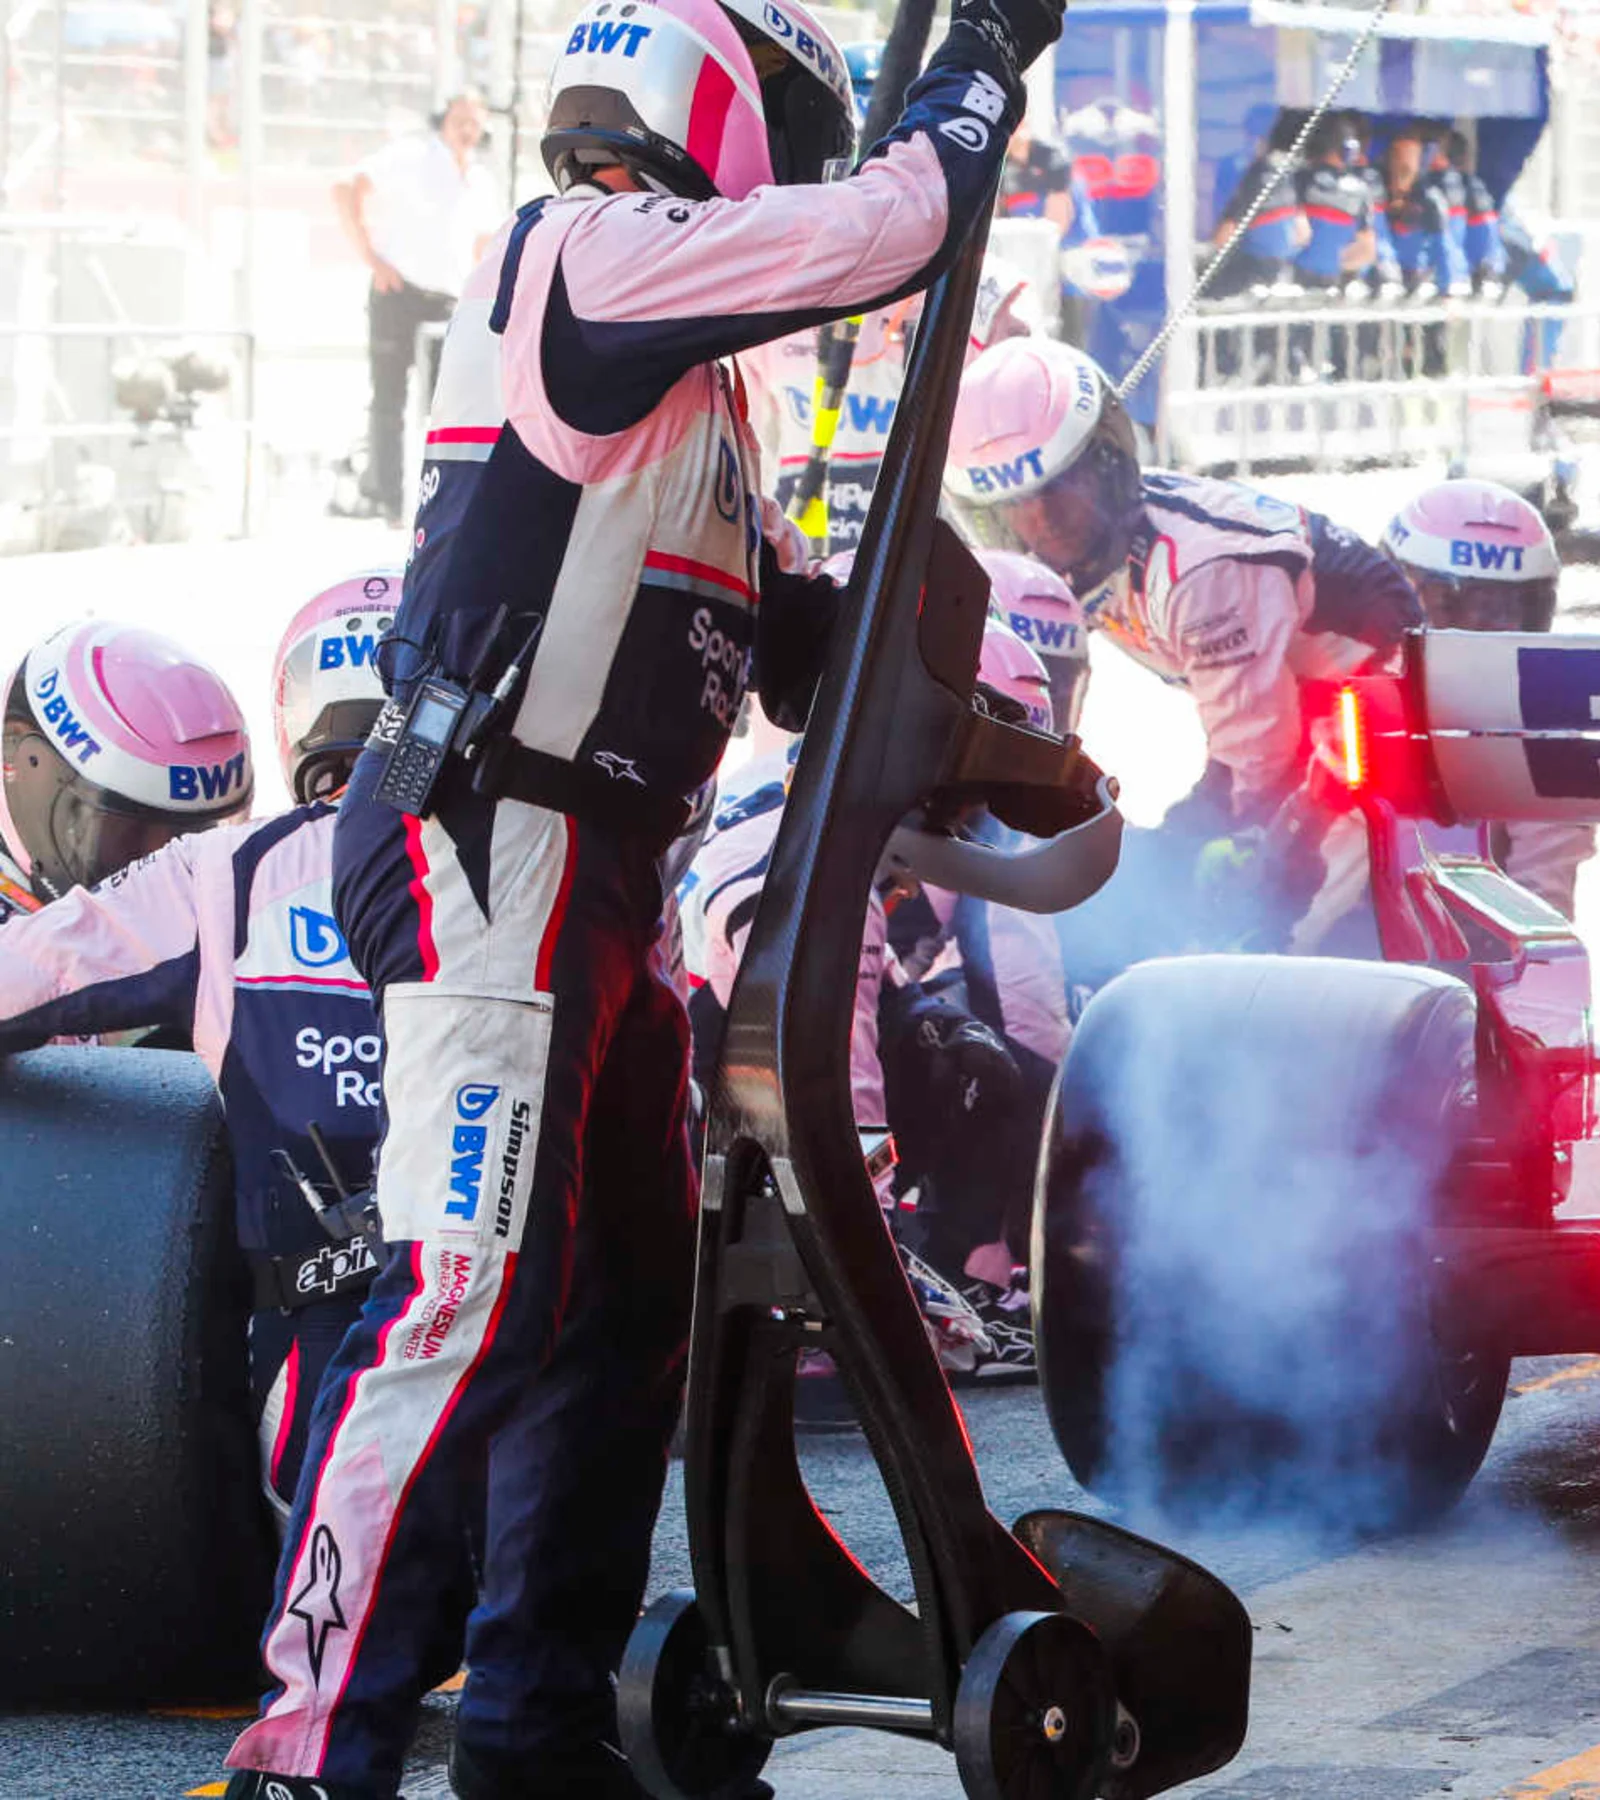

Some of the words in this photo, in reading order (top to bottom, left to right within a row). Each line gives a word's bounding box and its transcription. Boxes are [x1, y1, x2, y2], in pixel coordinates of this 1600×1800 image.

[565, 22, 652, 58] BWT
[969, 448, 1045, 494] BWT
[1451, 539, 1525, 571] BWT
[1009, 611, 1080, 649] BWT
[43, 694, 103, 765] BWT
[169, 752, 246, 801] BWT
[445, 1124, 491, 1221] BWT
[495, 1100, 531, 1239] Simpson
[418, 1253, 473, 1360] MAGNESIUM
[404, 1322, 429, 1360] WATER
